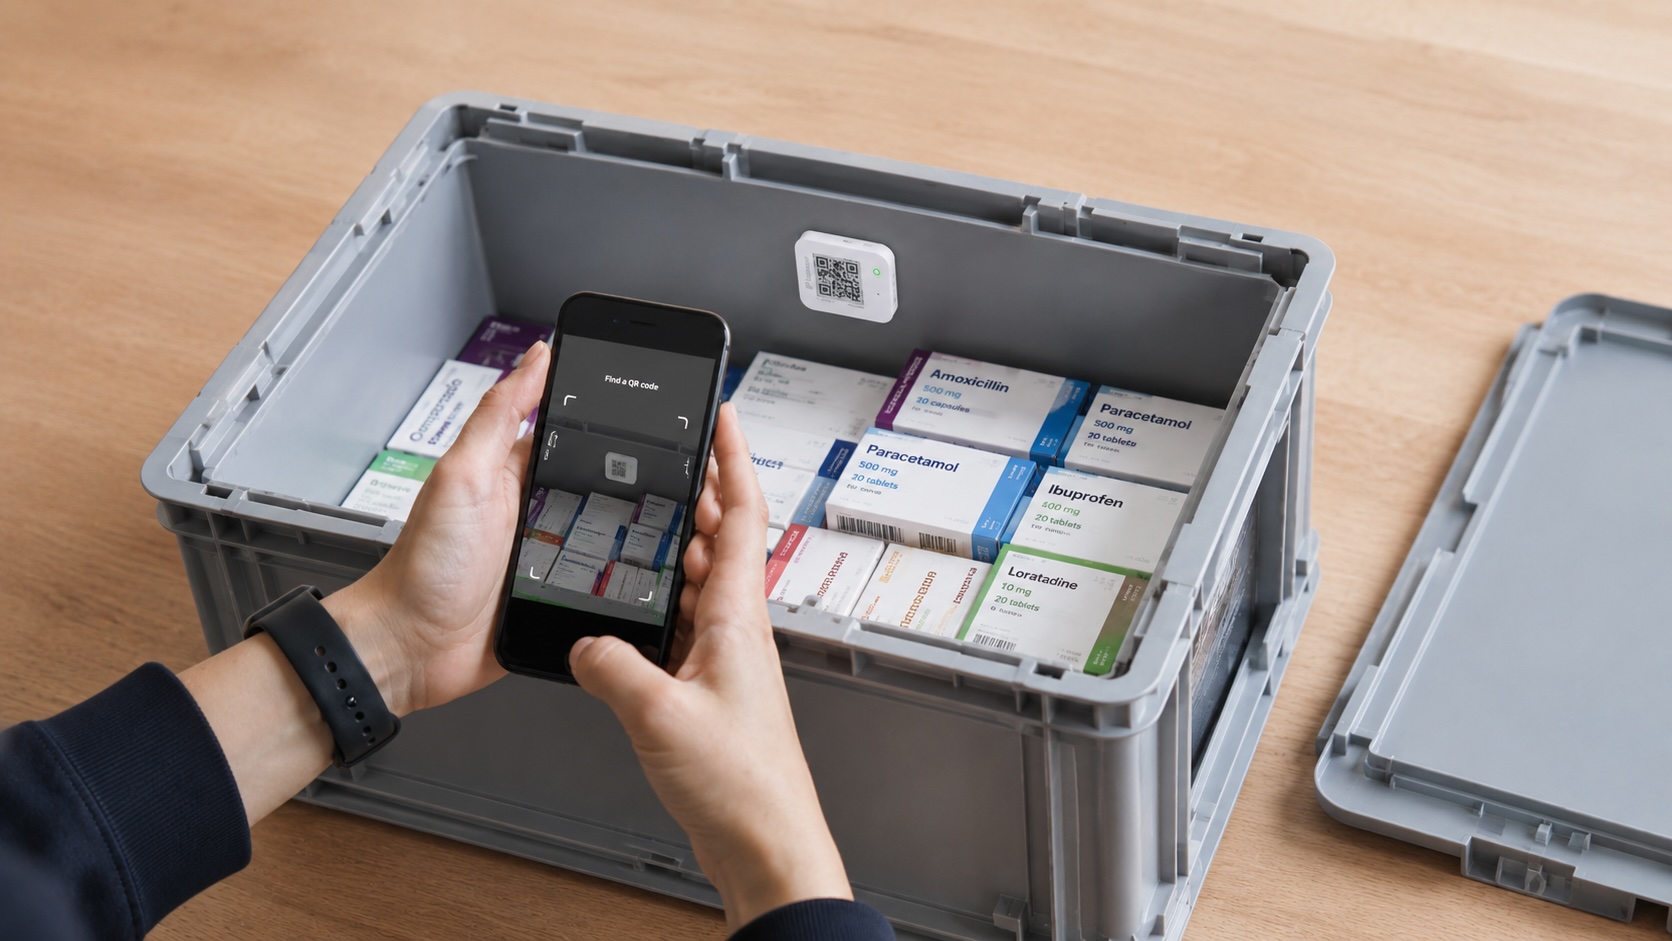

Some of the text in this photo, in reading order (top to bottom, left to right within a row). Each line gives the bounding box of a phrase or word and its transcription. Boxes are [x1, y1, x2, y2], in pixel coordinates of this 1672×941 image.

[628, 379, 640, 388] QR
[640, 382, 659, 391] code
[929, 369, 1010, 394] Amoxicillin
[916, 396, 929, 405] 20
[922, 384, 962, 400] 500 mg
[1100, 403, 1193, 430] Paracetamol
[1093, 419, 1134, 435] 500 mg
[866, 444, 960, 473] Paracetamol
[858, 460, 899, 477] 500 mg
[851, 473, 865, 483] 20
[866, 475, 899, 490] tablets
[1048, 484, 1124, 509] Ibuprofen
[1062, 506, 1081, 517] mg
[1034, 513, 1049, 523] 20
[1049, 517, 1082, 530] tablets
[1007, 566, 1078, 590] Loratadine
[1000, 582, 1032, 597] 10 mg
[994, 595, 1008, 604] 20
[1009, 599, 1040, 612] tablets
